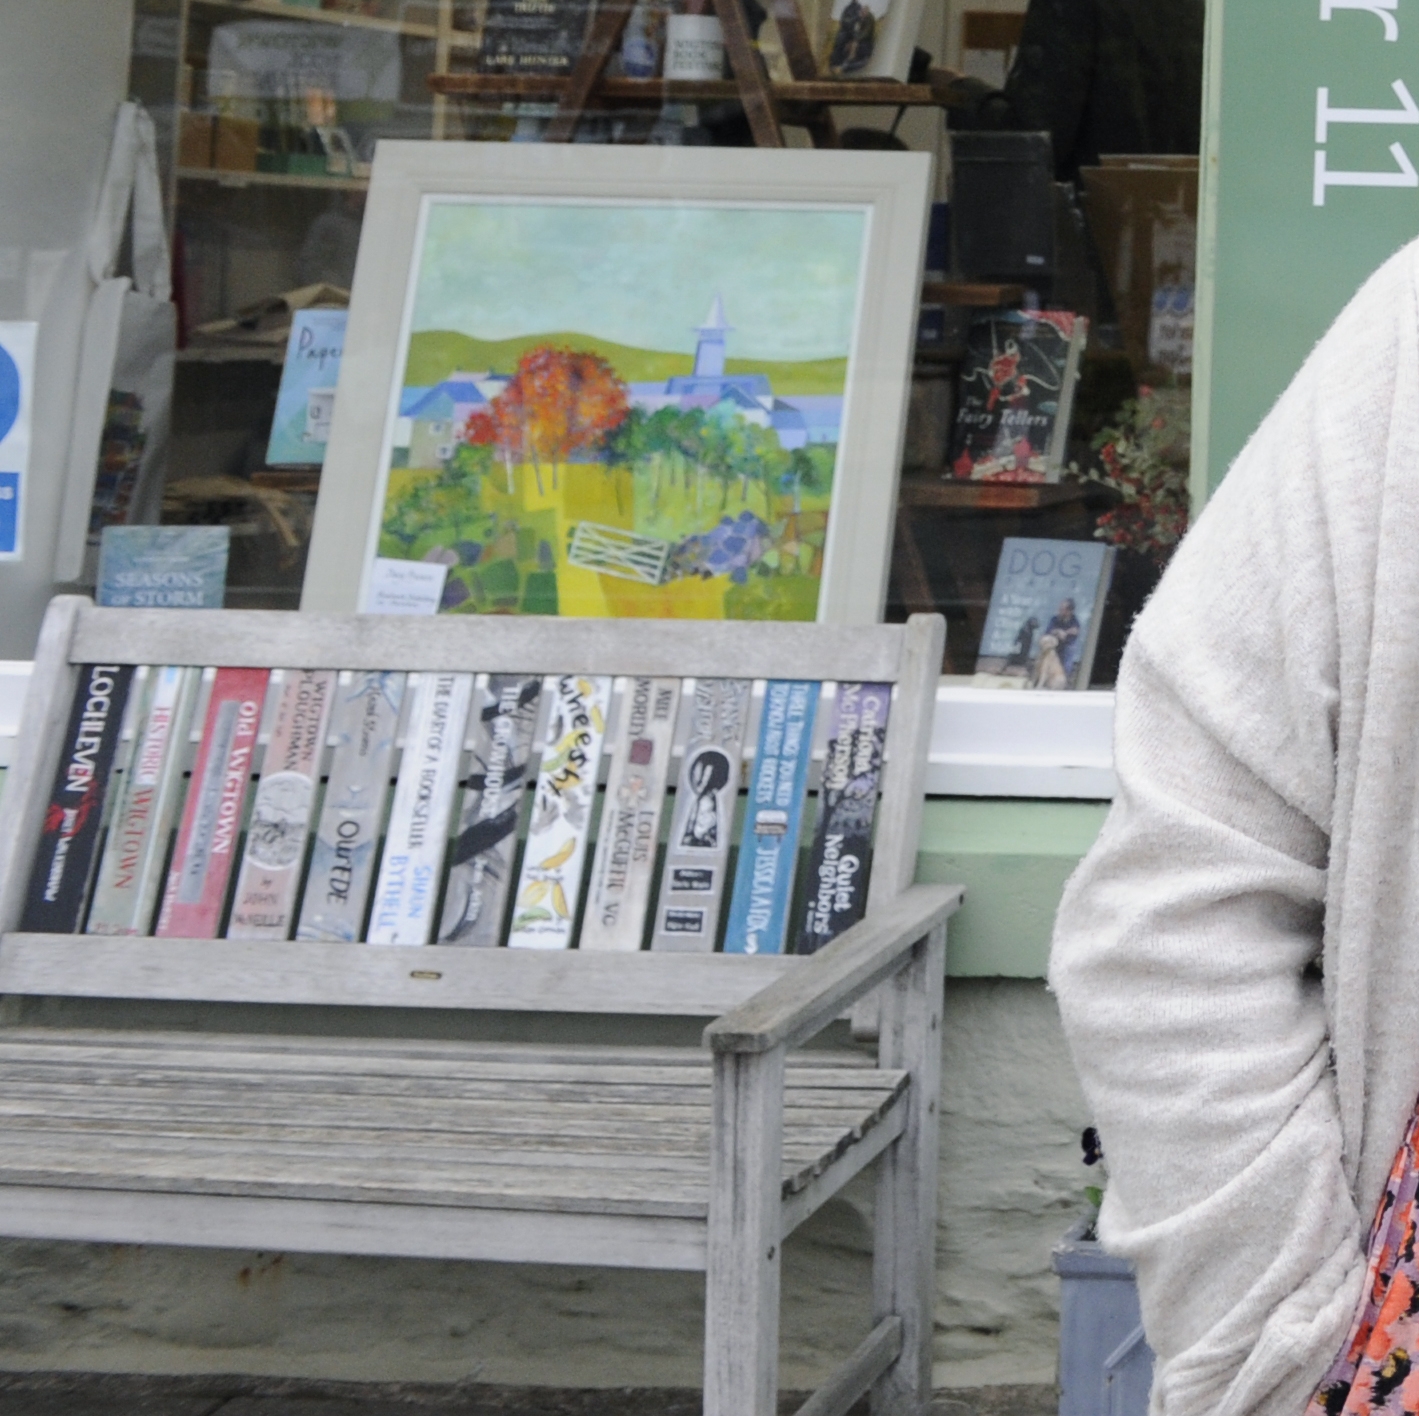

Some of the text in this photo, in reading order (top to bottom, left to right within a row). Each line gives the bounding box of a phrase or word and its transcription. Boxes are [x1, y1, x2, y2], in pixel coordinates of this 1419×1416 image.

[297, 326, 342, 372] Pape
[956, 407, 1049, 429] Fairy Tellers
[114, 570, 205, 587] SEASONS
[1008, 548, 1082, 578] DOG
[134, 589, 205, 606] STORM
[434, 676, 455, 699] THE
[63, 665, 121, 794] LOCHLEVEN
[139, 704, 173, 783] HISTORIC
[284, 670, 316, 771] PLOUGHMAN
[300, 680, 327, 762] WIGTOWN
[425, 735, 443, 753] OF
[428, 701, 450, 734] DIARY
[828, 683, 861, 790] McPherson
[853, 694, 882, 775] Catriona
[211, 700, 258, 855] Old WIGTOWN
[755, 756, 779, 804] ROCKETS
[407, 767, 437, 850] BOOKSELLER
[114, 788, 154, 889] WIGTOWN
[632, 810, 655, 863] LOUIS
[378, 854, 409, 930] BYTHELL
[407, 865, 433, 919] SHAUN
[753, 845, 780, 894] JESSICA
[811, 833, 845, 935] Neighbors
[833, 853, 861, 912] Quiet
[601, 901, 620, 927] VC
